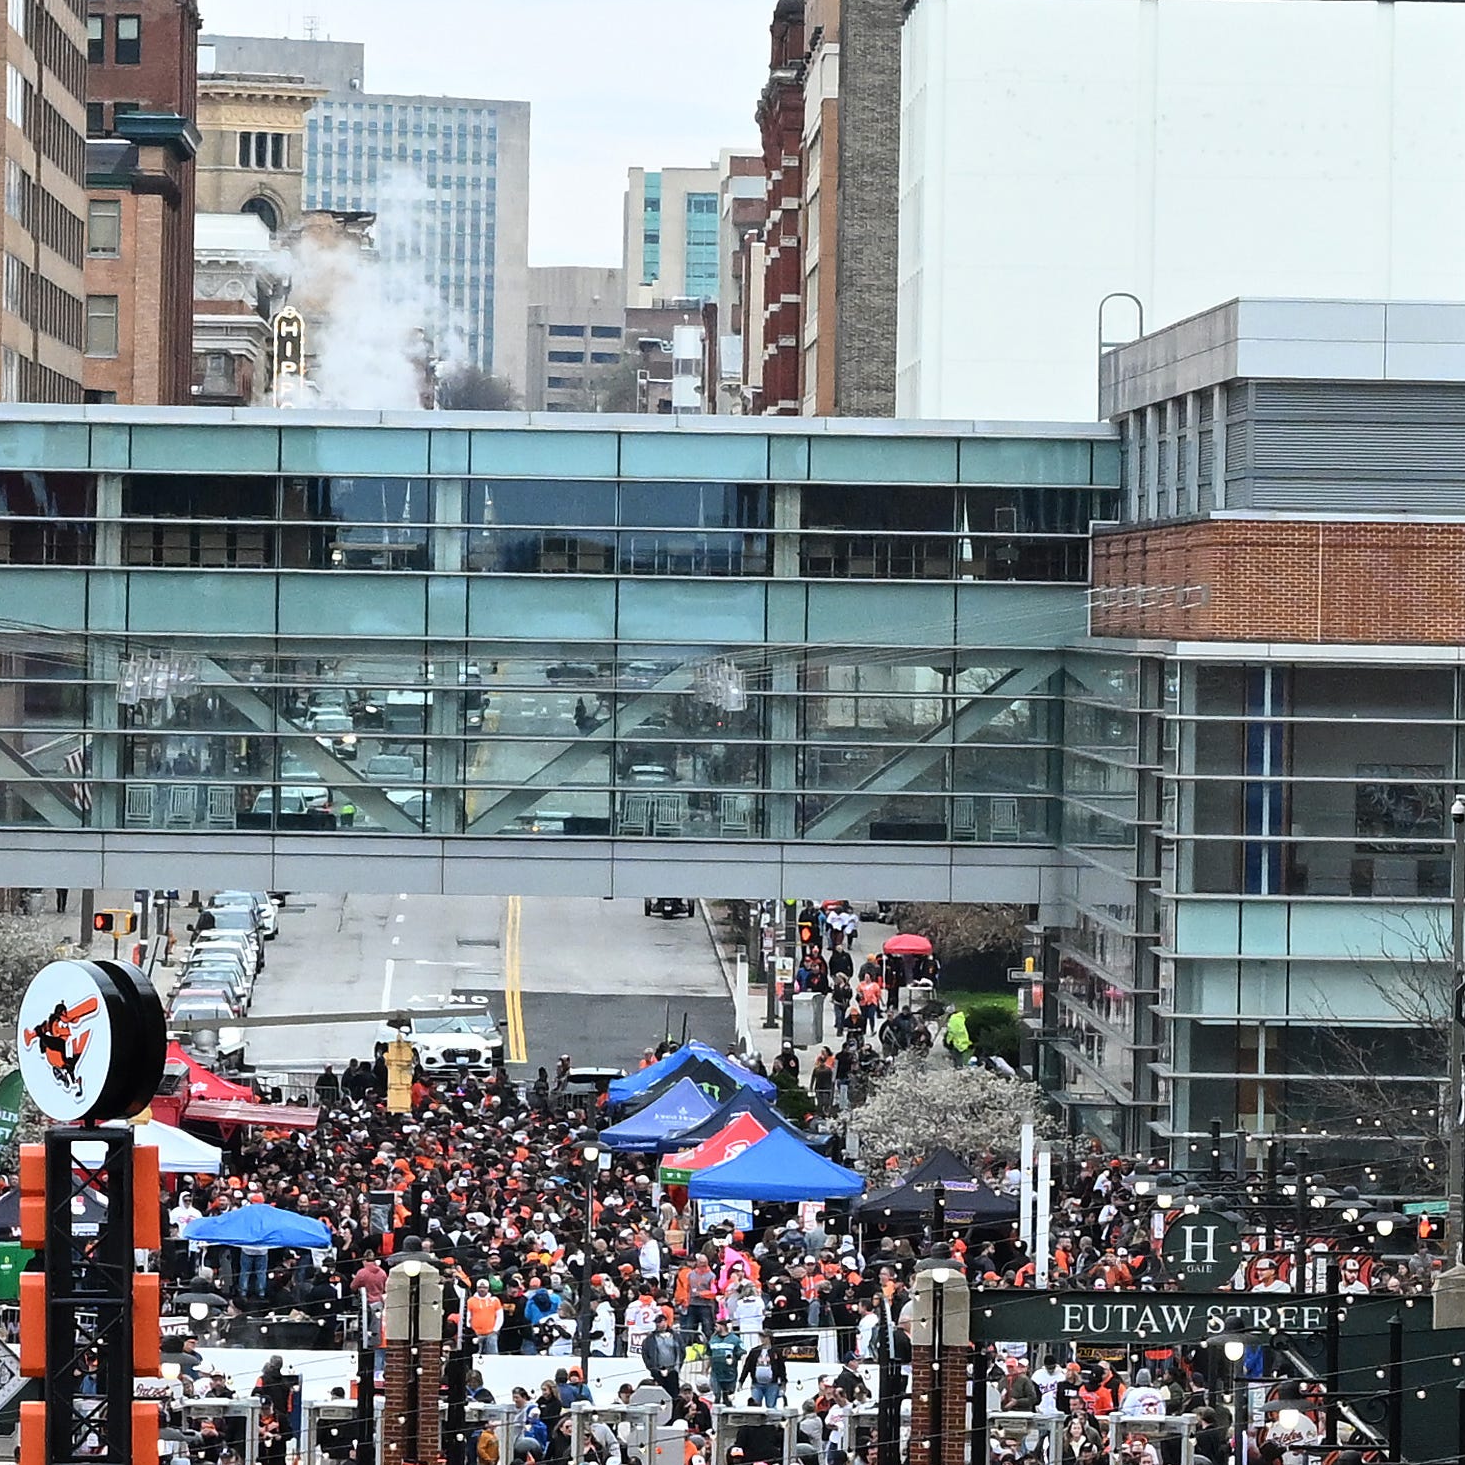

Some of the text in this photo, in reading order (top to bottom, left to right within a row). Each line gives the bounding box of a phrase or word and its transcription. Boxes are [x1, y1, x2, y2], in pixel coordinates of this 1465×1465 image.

[1181, 1224, 1219, 1264] H
[1186, 1264, 1212, 1274] GATE
[1062, 1304, 1348, 1335] EUTAW STREE
